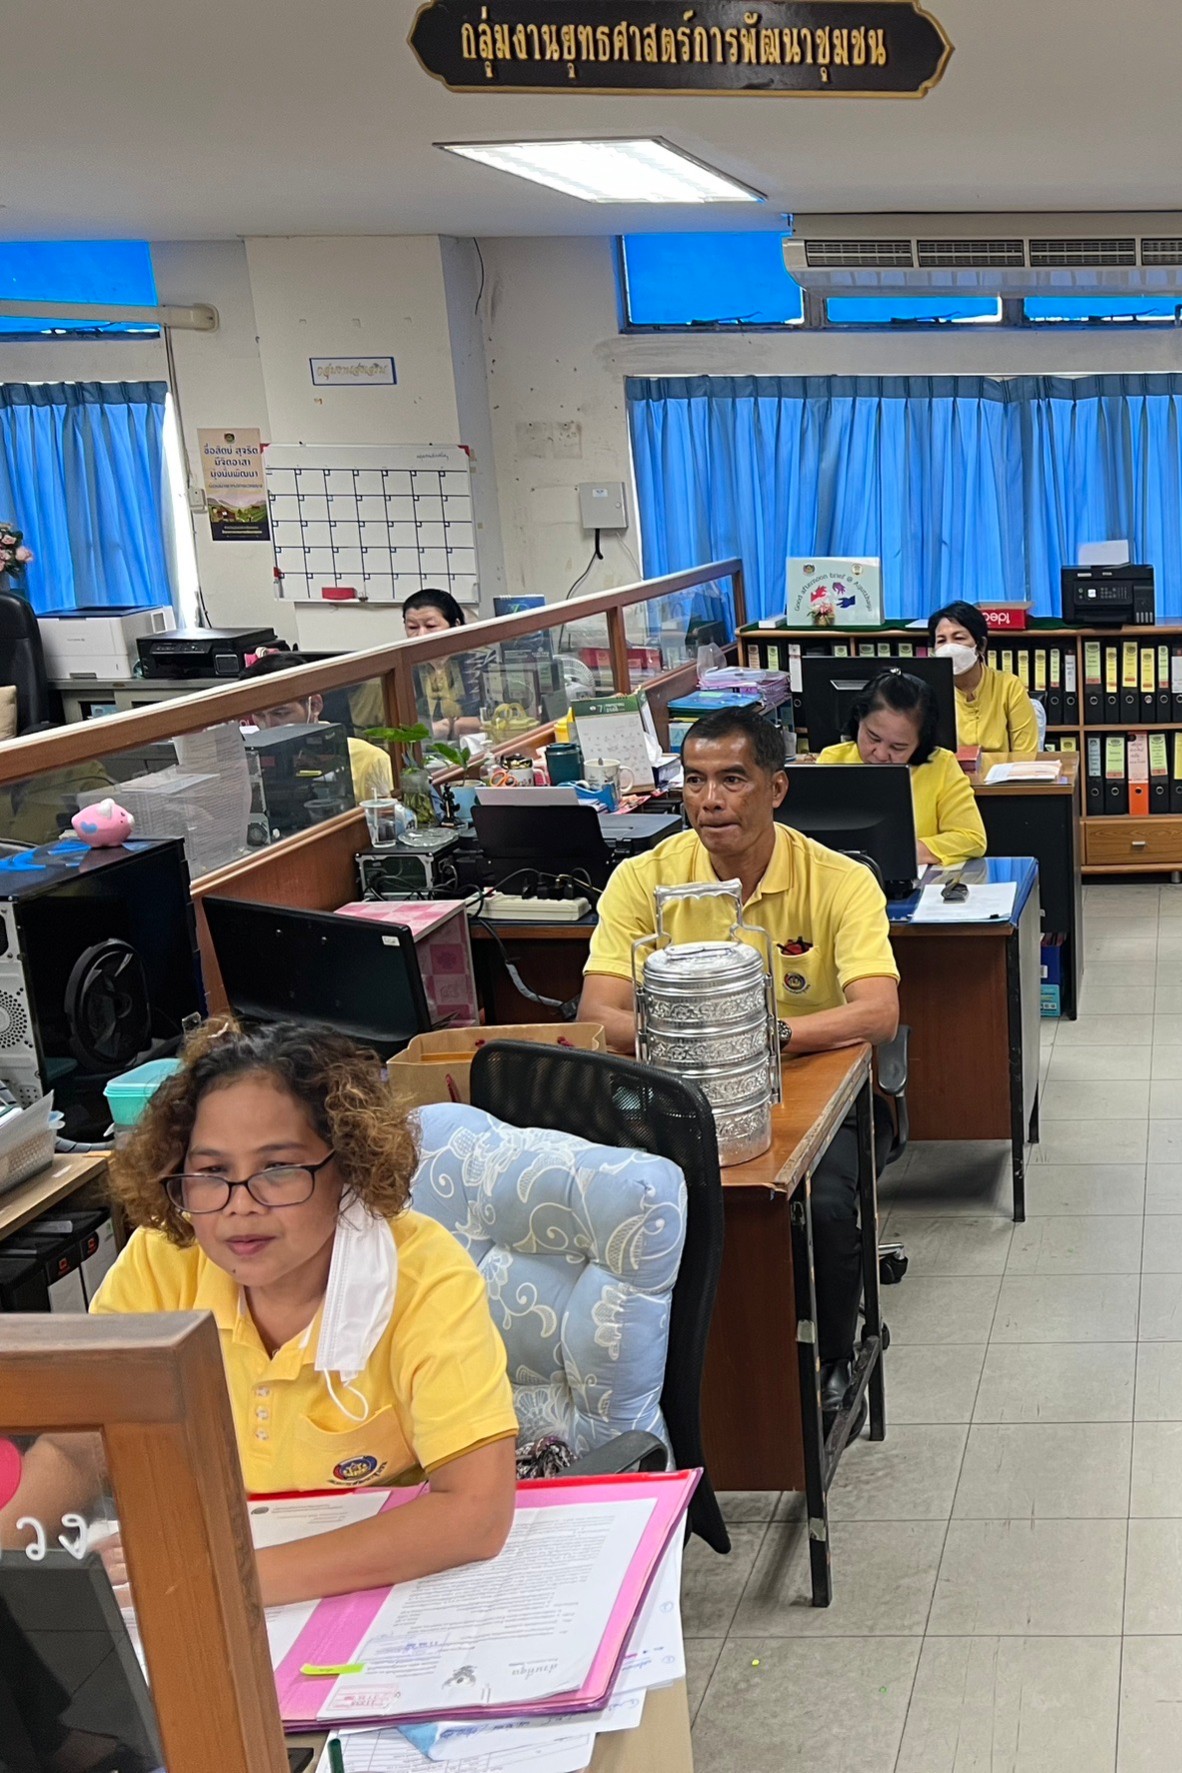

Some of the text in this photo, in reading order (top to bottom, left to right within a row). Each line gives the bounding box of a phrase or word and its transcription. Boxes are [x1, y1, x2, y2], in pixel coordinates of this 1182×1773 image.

[461, 5, 887, 82] กลุ่มงานยุทธศาสตร์การพัฒนาชุมชน
[0, 1513, 87, 1560] วง
